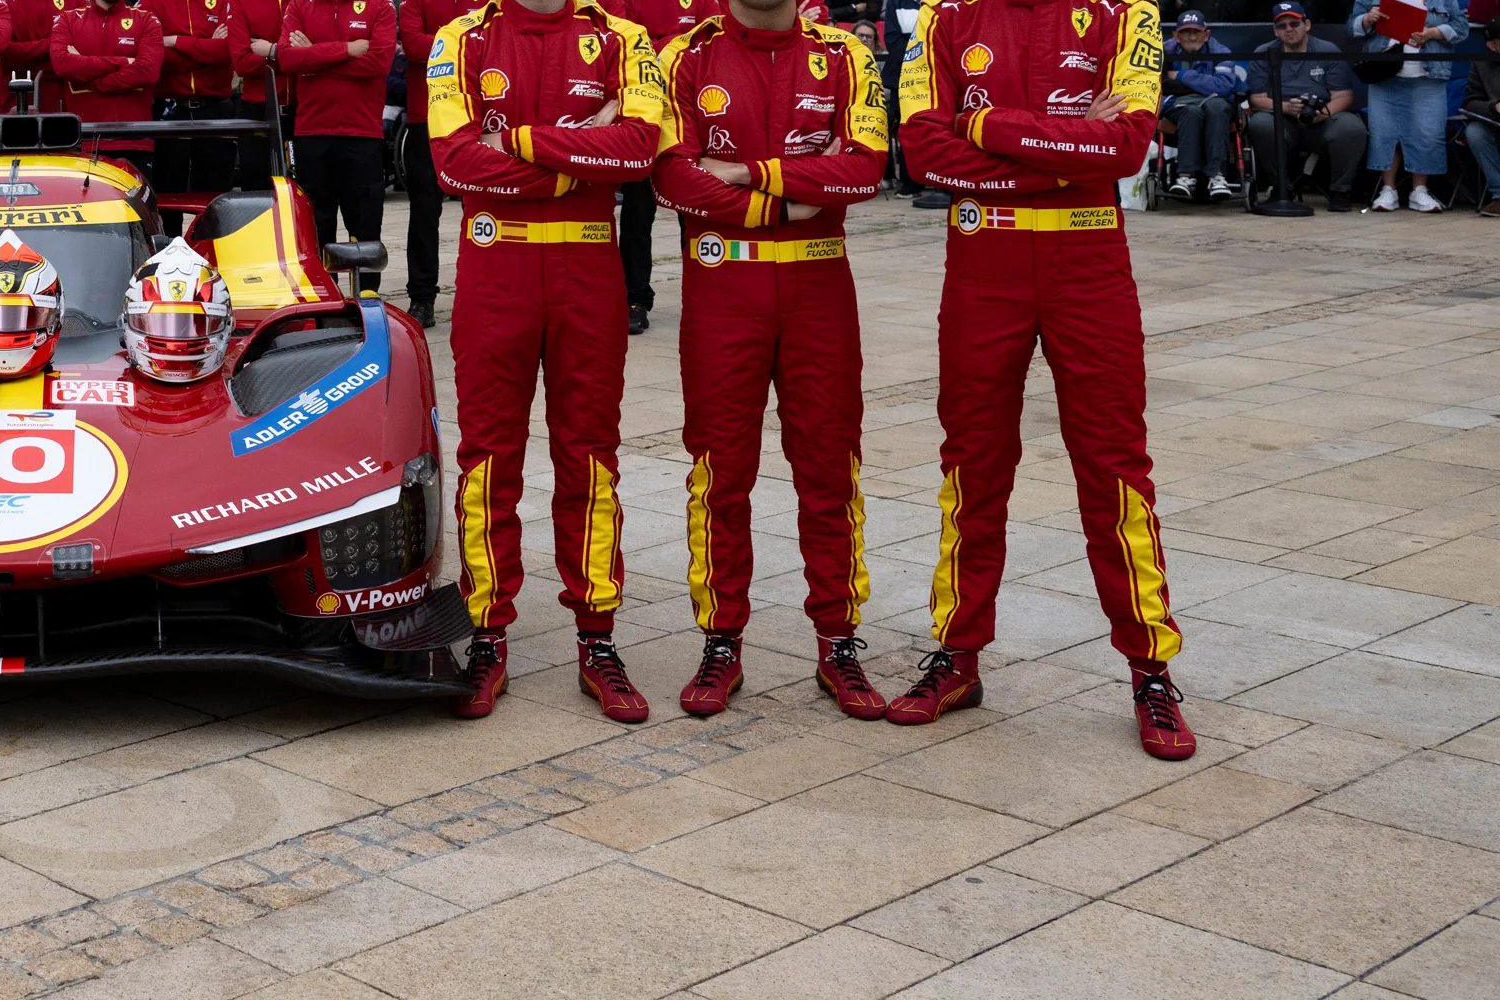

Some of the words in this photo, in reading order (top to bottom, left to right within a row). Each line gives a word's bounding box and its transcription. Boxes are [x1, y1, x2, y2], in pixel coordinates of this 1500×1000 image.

[1021, 137, 1075, 152] RICHARD
[1079, 143, 1117, 155] MILLE
[570, 155, 621, 167] RICHARD
[440, 171, 484, 192] RICHARD
[487, 186, 520, 194] MILLE
[925, 171, 976, 189] RICHARD
[980, 180, 1016, 189] MILLE
[823, 185, 875, 194] RICHARD
[674, 204, 709, 218] MILLE
[959, 208, 978, 224] 50
[1070, 208, 1115, 219] NICKLAS
[474, 221, 493, 237] 50
[582, 224, 610, 232] MIGUEL
[1069, 218, 1115, 227] NIELSEN
[581, 232, 611, 241] MOLINA
[805, 238, 843, 249] ANTONIO
[700, 241, 722, 257] 50
[805, 248, 838, 257] FUOCO
[56, 381, 128, 391] HYPER
[56, 389, 129, 404] CAR
[242, 411, 309, 449] ADLER
[324, 363, 380, 402] GROUP
[171, 487, 298, 529] RICHARD
[300, 456, 382, 495] MILLE
